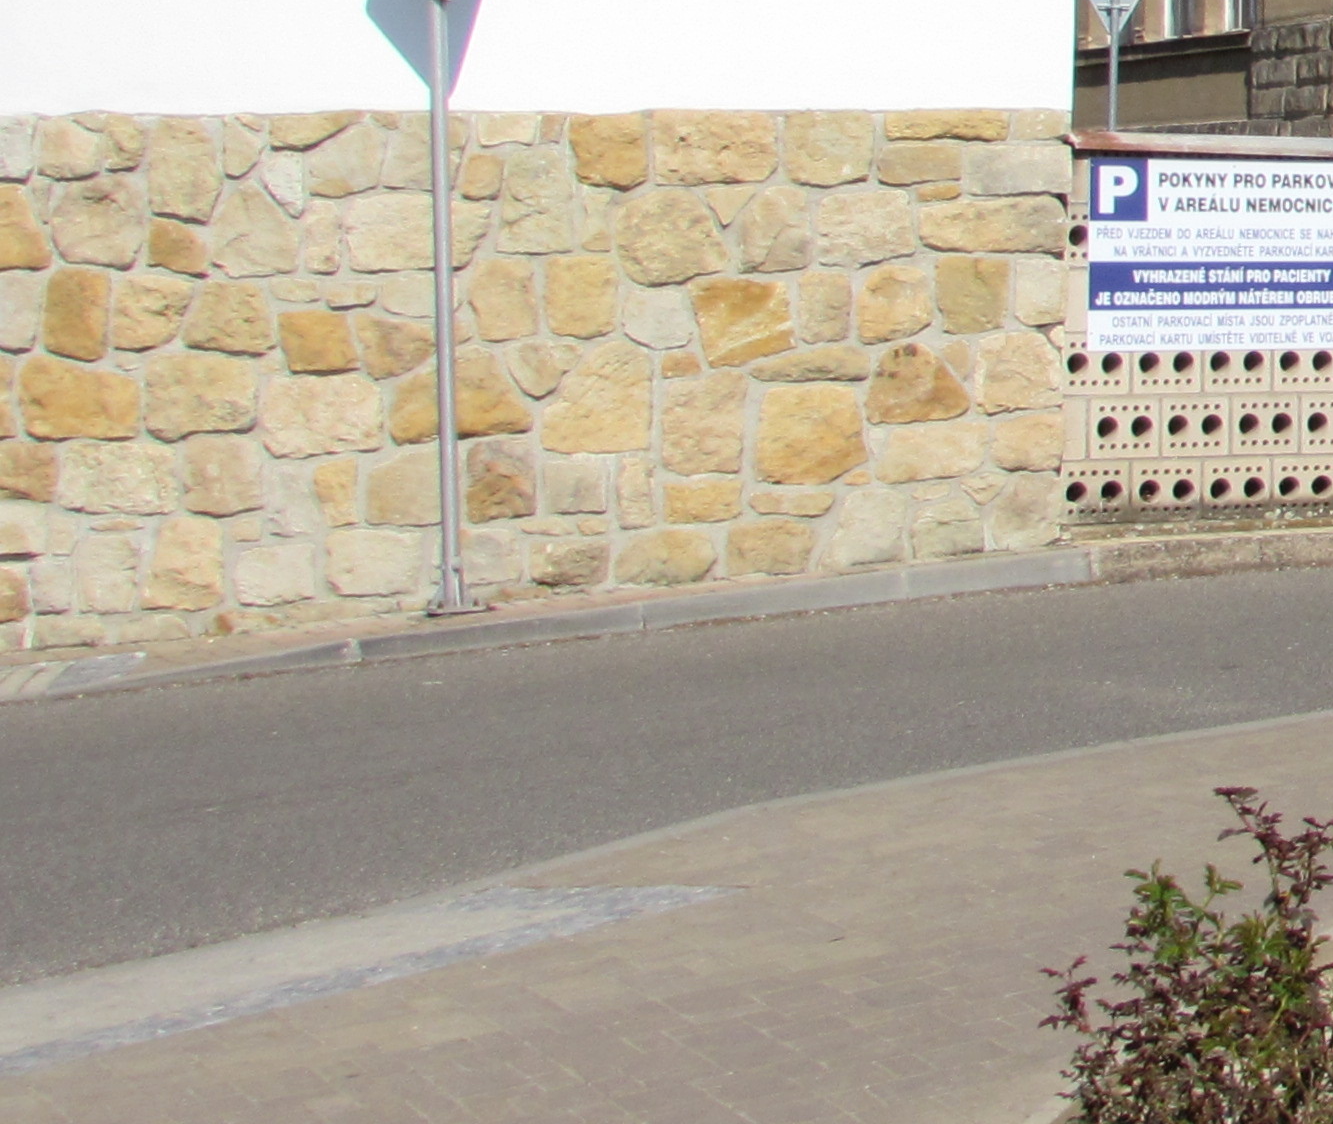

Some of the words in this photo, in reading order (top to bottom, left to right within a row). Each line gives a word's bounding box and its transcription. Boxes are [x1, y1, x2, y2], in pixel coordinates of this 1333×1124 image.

[1158, 172, 1229, 188] POKYNY
[1233, 173, 1267, 189] PRO
[1158, 197, 1169, 213] V
[1174, 193, 1241, 213] AREÁLU
[1096, 226, 1123, 240] PŘED
[1127, 228, 1172, 240] VJEZDEM
[1177, 228, 1191, 240] DO
[1195, 226, 1234, 240] AREÁLU
[1239, 228, 1296, 240] NEMOCNICE
[1299, 228, 1312, 240] SE
[1113, 246, 1127, 257] NA
[1132, 243, 1177, 257] VRÁTNICI
[1181, 246, 1188, 257] A
[1192, 243, 1254, 257] VYZVEDNĚTE
[1259, 243, 1313, 257] PARKOVACÍ
[1132, 266, 1206, 284] VYHRAZENÉ
[1208, 266, 1244, 284] STÁNÍ
[1246, 269, 1271, 283] PRO
[1273, 269, 1331, 283] PACIENTY
[1095, 291, 1111, 306] JE
[1113, 288, 1181, 306] OZNAČENO
[1183, 288, 1236, 305] MODRÝM
[1238, 288, 1294, 305] NÁTĚREM
[1112, 314, 1152, 328] OSTATNÍ
[1157, 314, 1213, 327] PARKOVACÍ
[1217, 314, 1245, 327] MÍSTA
[1250, 315, 1275, 326] JSOU
[1100, 332, 1155, 345] PARKOVACÍ
[1160, 333, 1193, 345] KARTU
[1198, 331, 1245, 344] UMÍSTĚTE
[1250, 330, 1297, 343] VIDITELNĚ
[1302, 331, 1315, 343] VE
